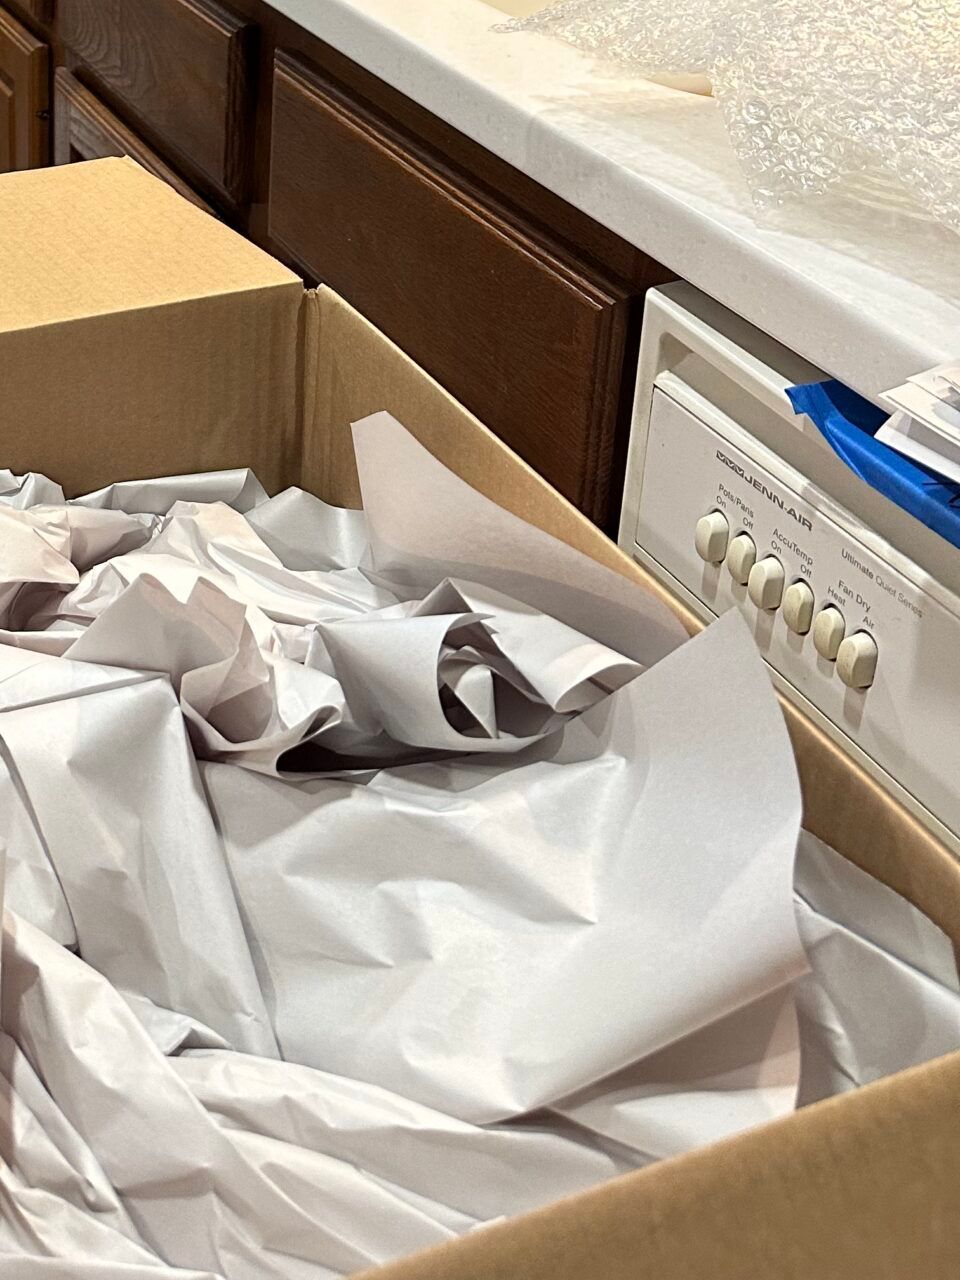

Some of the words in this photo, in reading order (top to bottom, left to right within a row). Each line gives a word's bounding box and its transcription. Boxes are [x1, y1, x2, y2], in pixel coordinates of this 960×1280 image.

[716, 495, 727, 508] On
[742, 516, 754, 530] Off
[718, 483, 754, 518] Pots/Pans
[744, 475, 813, 531] JENN-AIR
[771, 540, 782, 555] On
[800, 564, 812, 578] Off
[772, 528, 813, 566] AccuTemp
[841, 548, 874, 579] Ultimate
[875, 575, 897, 597] Quiet
[827, 585, 846, 607] Heat
[862, 616, 875, 629] Air
[838, 579, 854, 599] Fan
[855, 593, 871, 613] Dry
